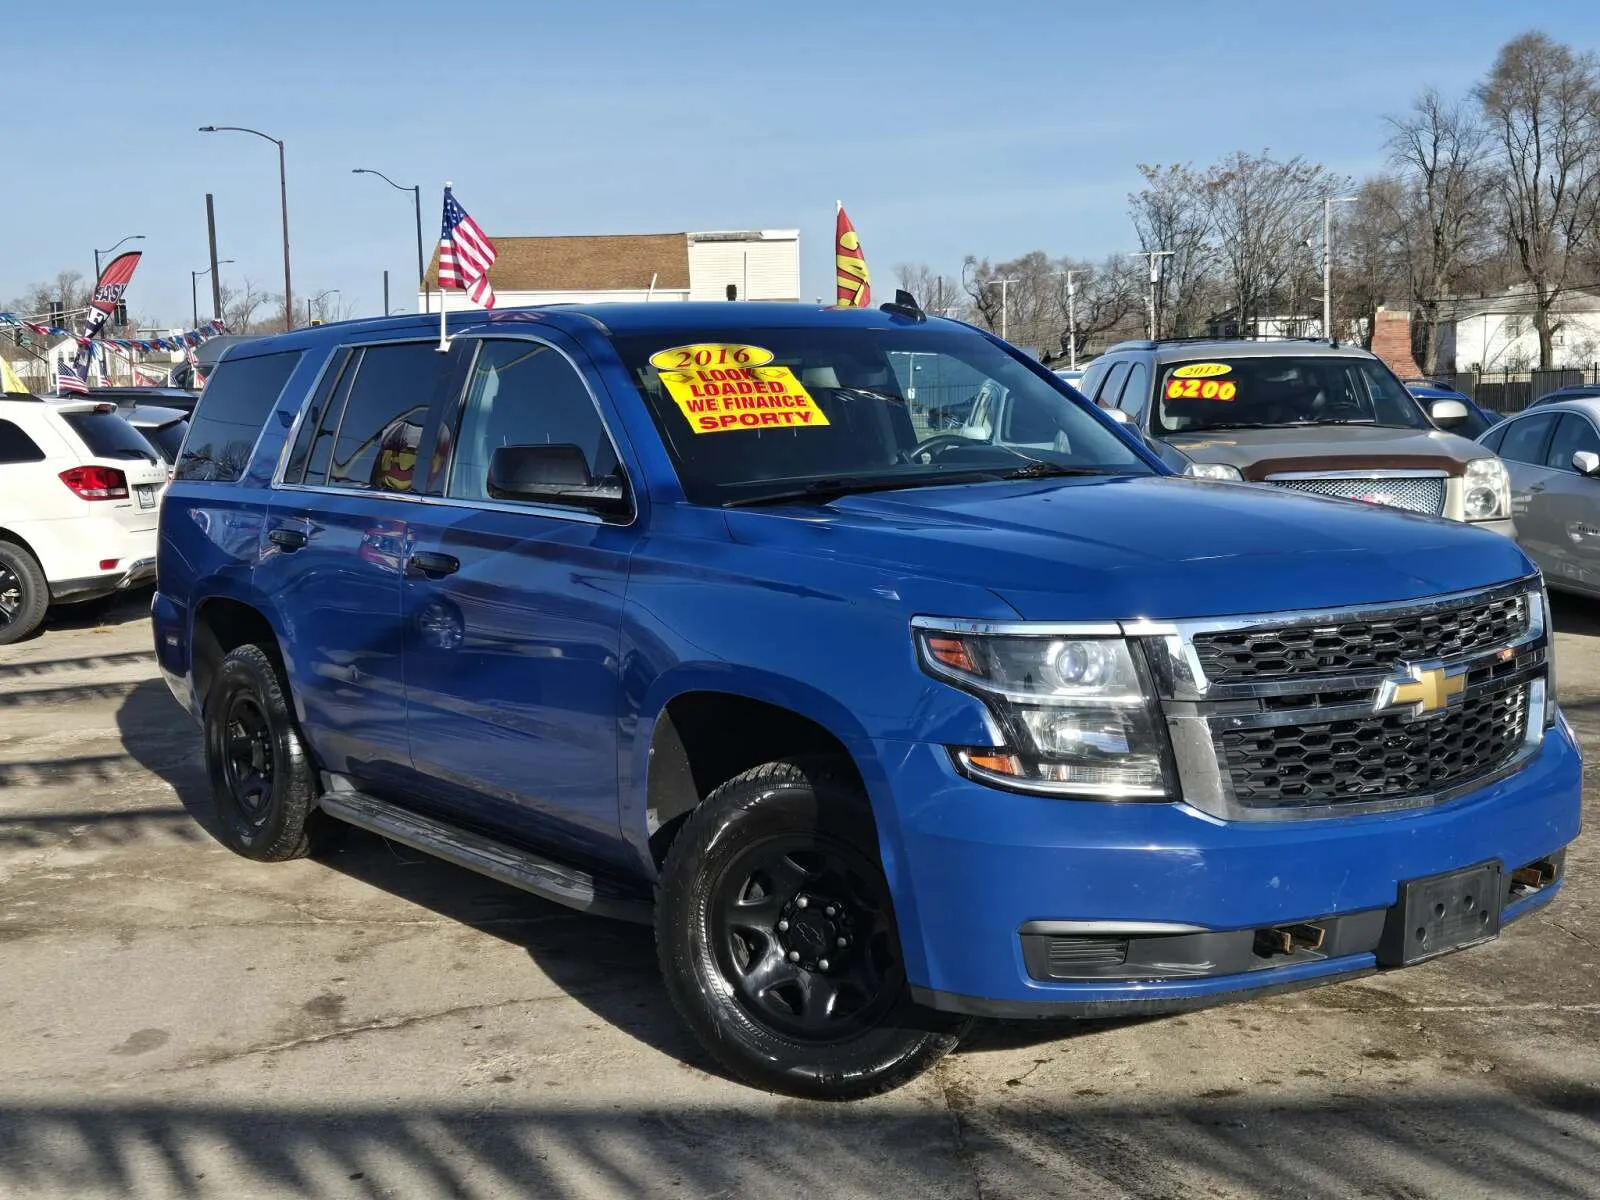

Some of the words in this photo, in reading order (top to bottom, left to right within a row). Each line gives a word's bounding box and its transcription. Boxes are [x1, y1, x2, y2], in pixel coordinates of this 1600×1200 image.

[676, 348, 751, 369] 2016
[695, 368, 759, 382] LOOK
[690, 381, 784, 398] LOADED
[1167, 380, 1237, 400] 6200
[686, 398, 720, 413] WE
[724, 395, 807, 410] FINANCE
[699, 411, 813, 430] SPORTY
